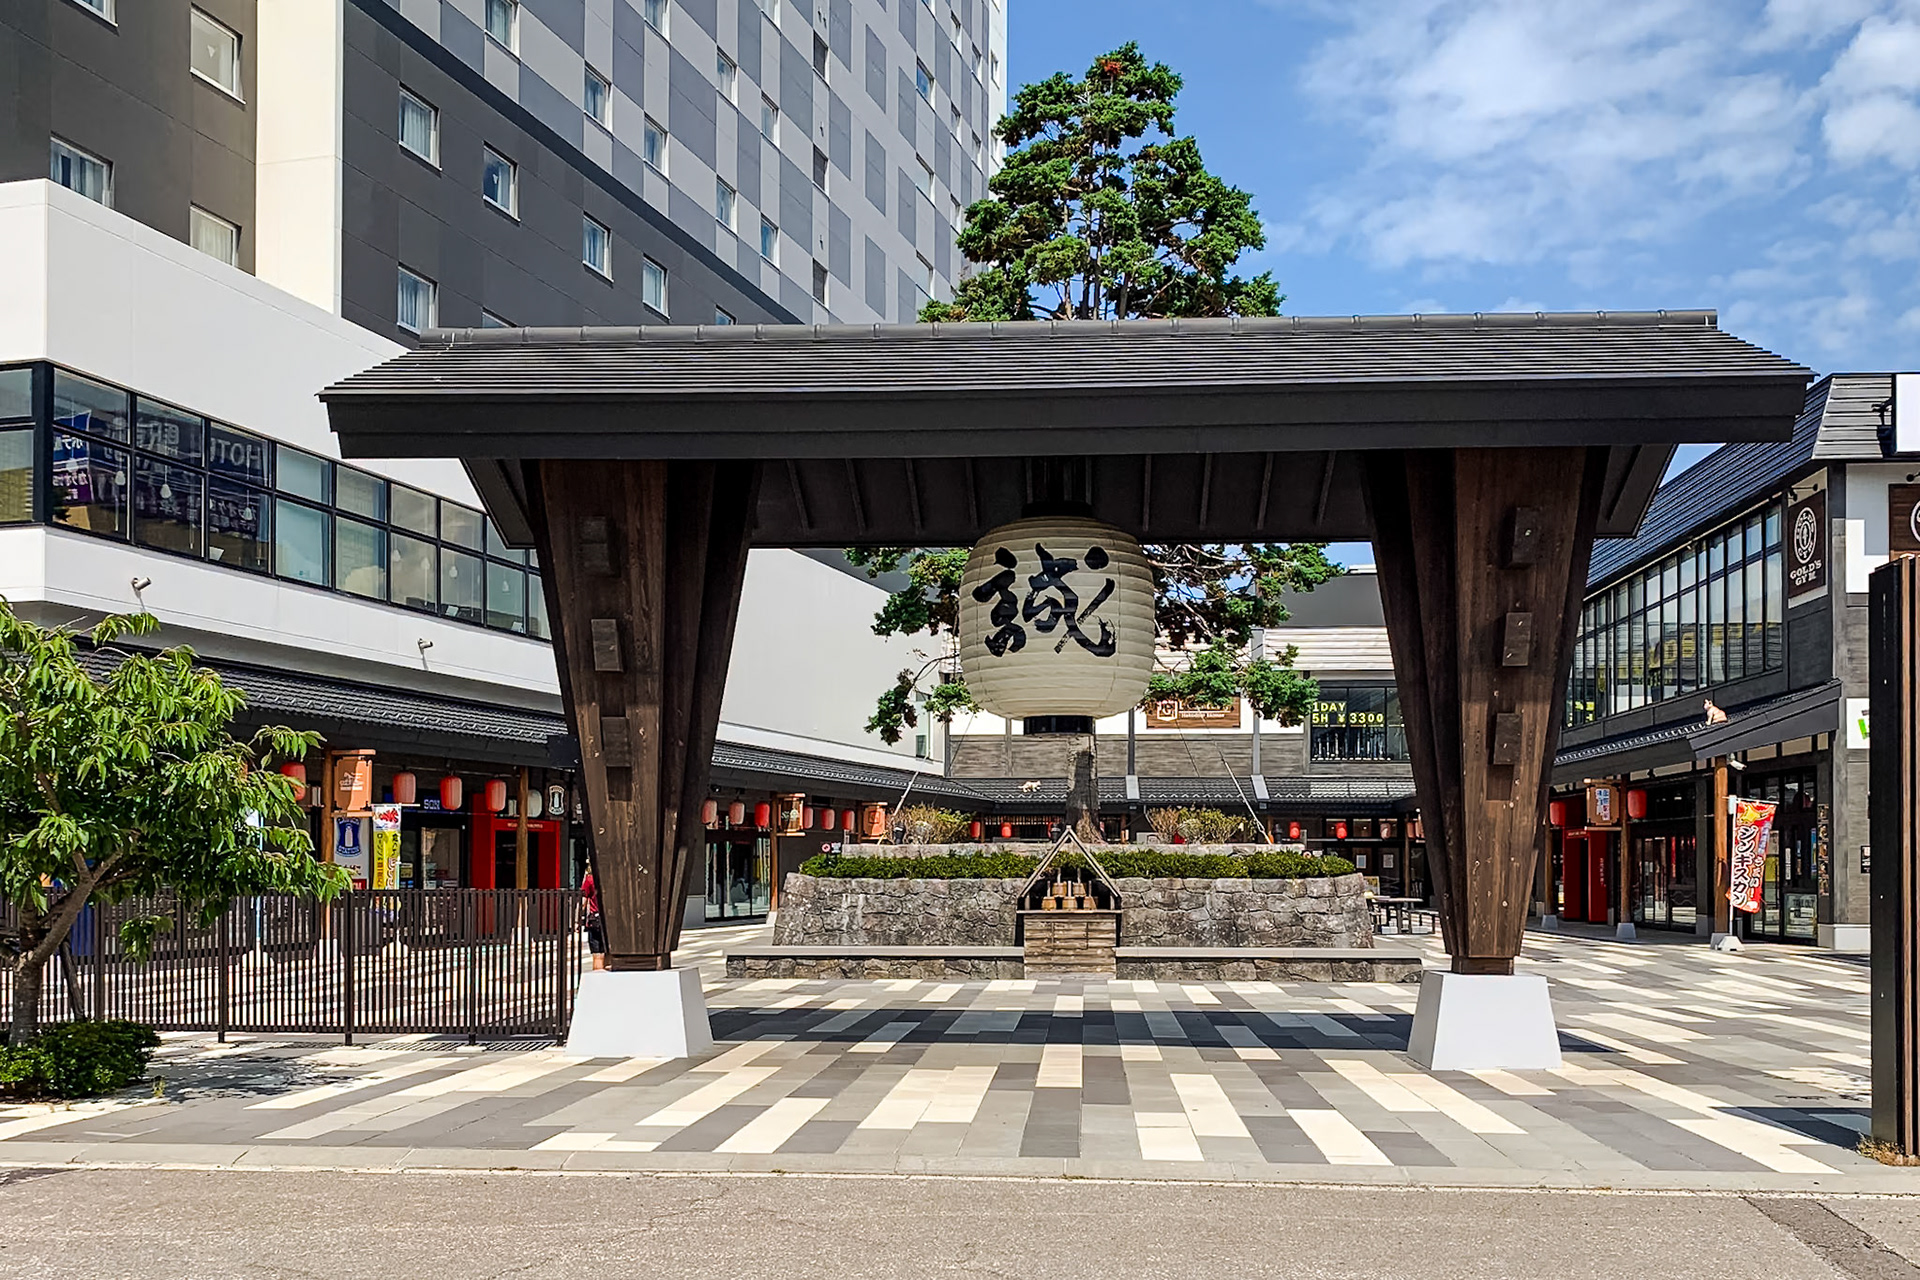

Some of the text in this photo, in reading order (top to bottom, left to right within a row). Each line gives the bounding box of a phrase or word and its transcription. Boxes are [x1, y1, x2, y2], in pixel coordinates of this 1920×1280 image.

[1789, 560, 1822, 580] GOLD'S
[1795, 571, 1817, 586] GYM
[972, 543, 1117, 657] 誠
[1313, 702, 1346, 712] 1DAY
[1312, 714, 1328, 723] 5H
[1732, 825, 1758, 906] ジンギスカン
